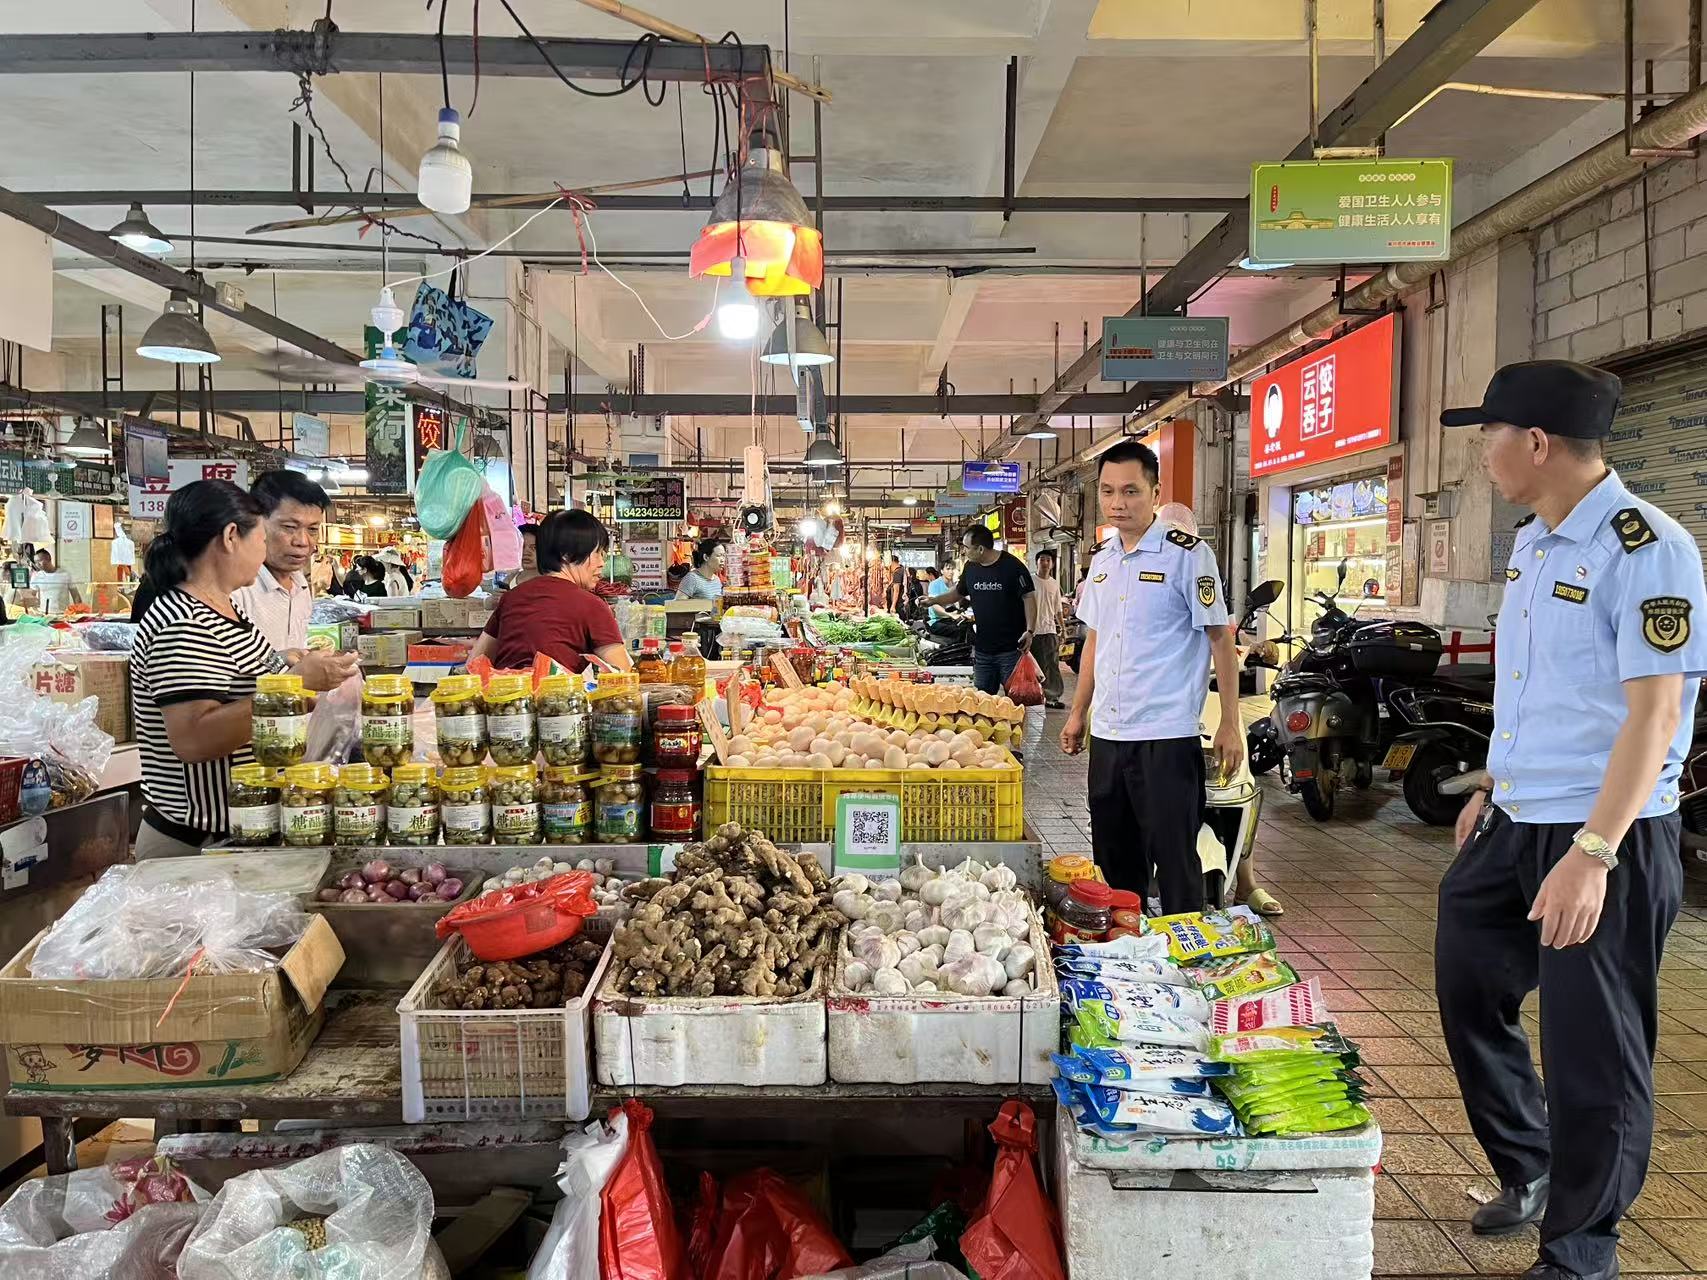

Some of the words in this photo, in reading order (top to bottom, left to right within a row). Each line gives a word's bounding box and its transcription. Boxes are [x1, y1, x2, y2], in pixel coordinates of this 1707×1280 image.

[1338, 194, 1441, 208] 爱国卫生人人参与
[1338, 213, 1441, 227] 健康生活人人享有
[1303, 370, 1316, 433] 云吞
[1319, 363, 1333, 429] 饺子
[619, 507, 682, 518] 13423429229
[36, 671, 76, 693] 片糖
[981, 1002, 1051, 1011] 1866476219
